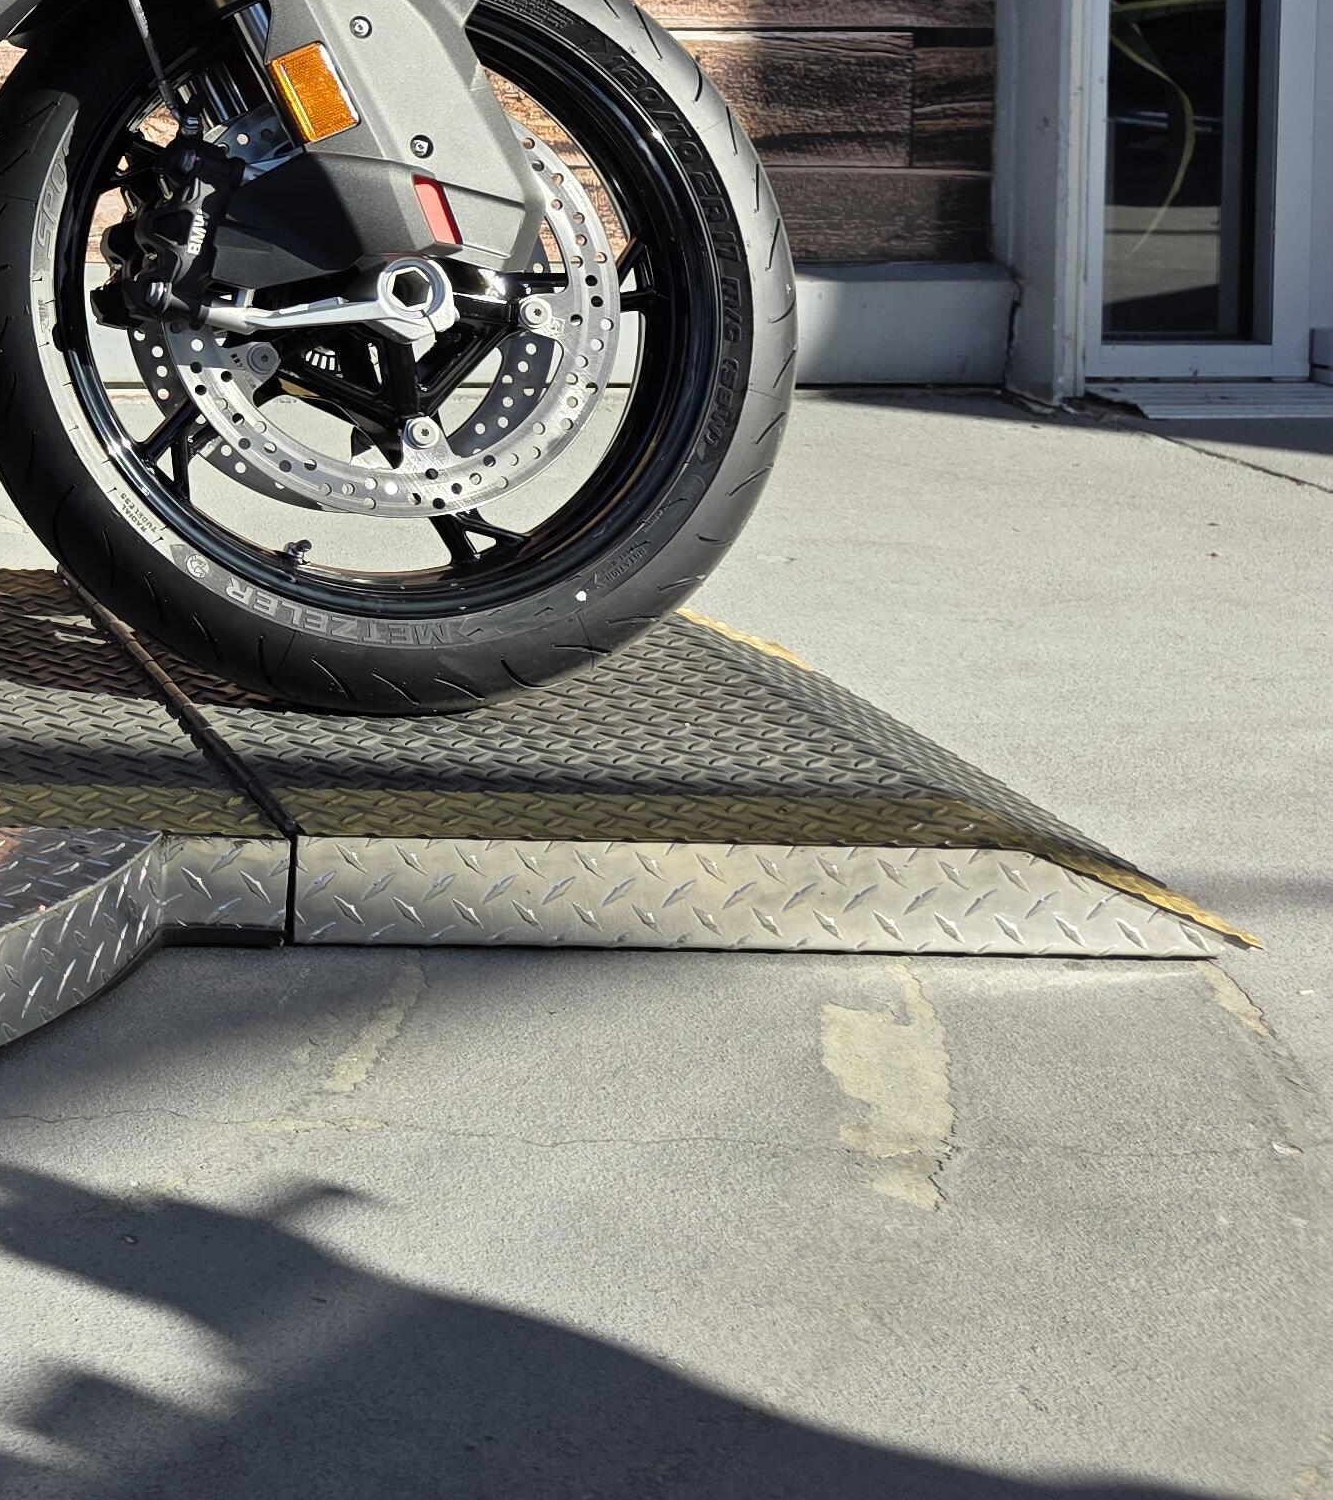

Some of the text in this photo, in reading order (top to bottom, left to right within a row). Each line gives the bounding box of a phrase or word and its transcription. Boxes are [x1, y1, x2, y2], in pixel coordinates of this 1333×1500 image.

[187, 214, 207, 255] BMW
[119, 492, 158, 534] TUBELESS
[121, 502, 148, 533] RADIAL
[224, 576, 448, 648] METZELER
